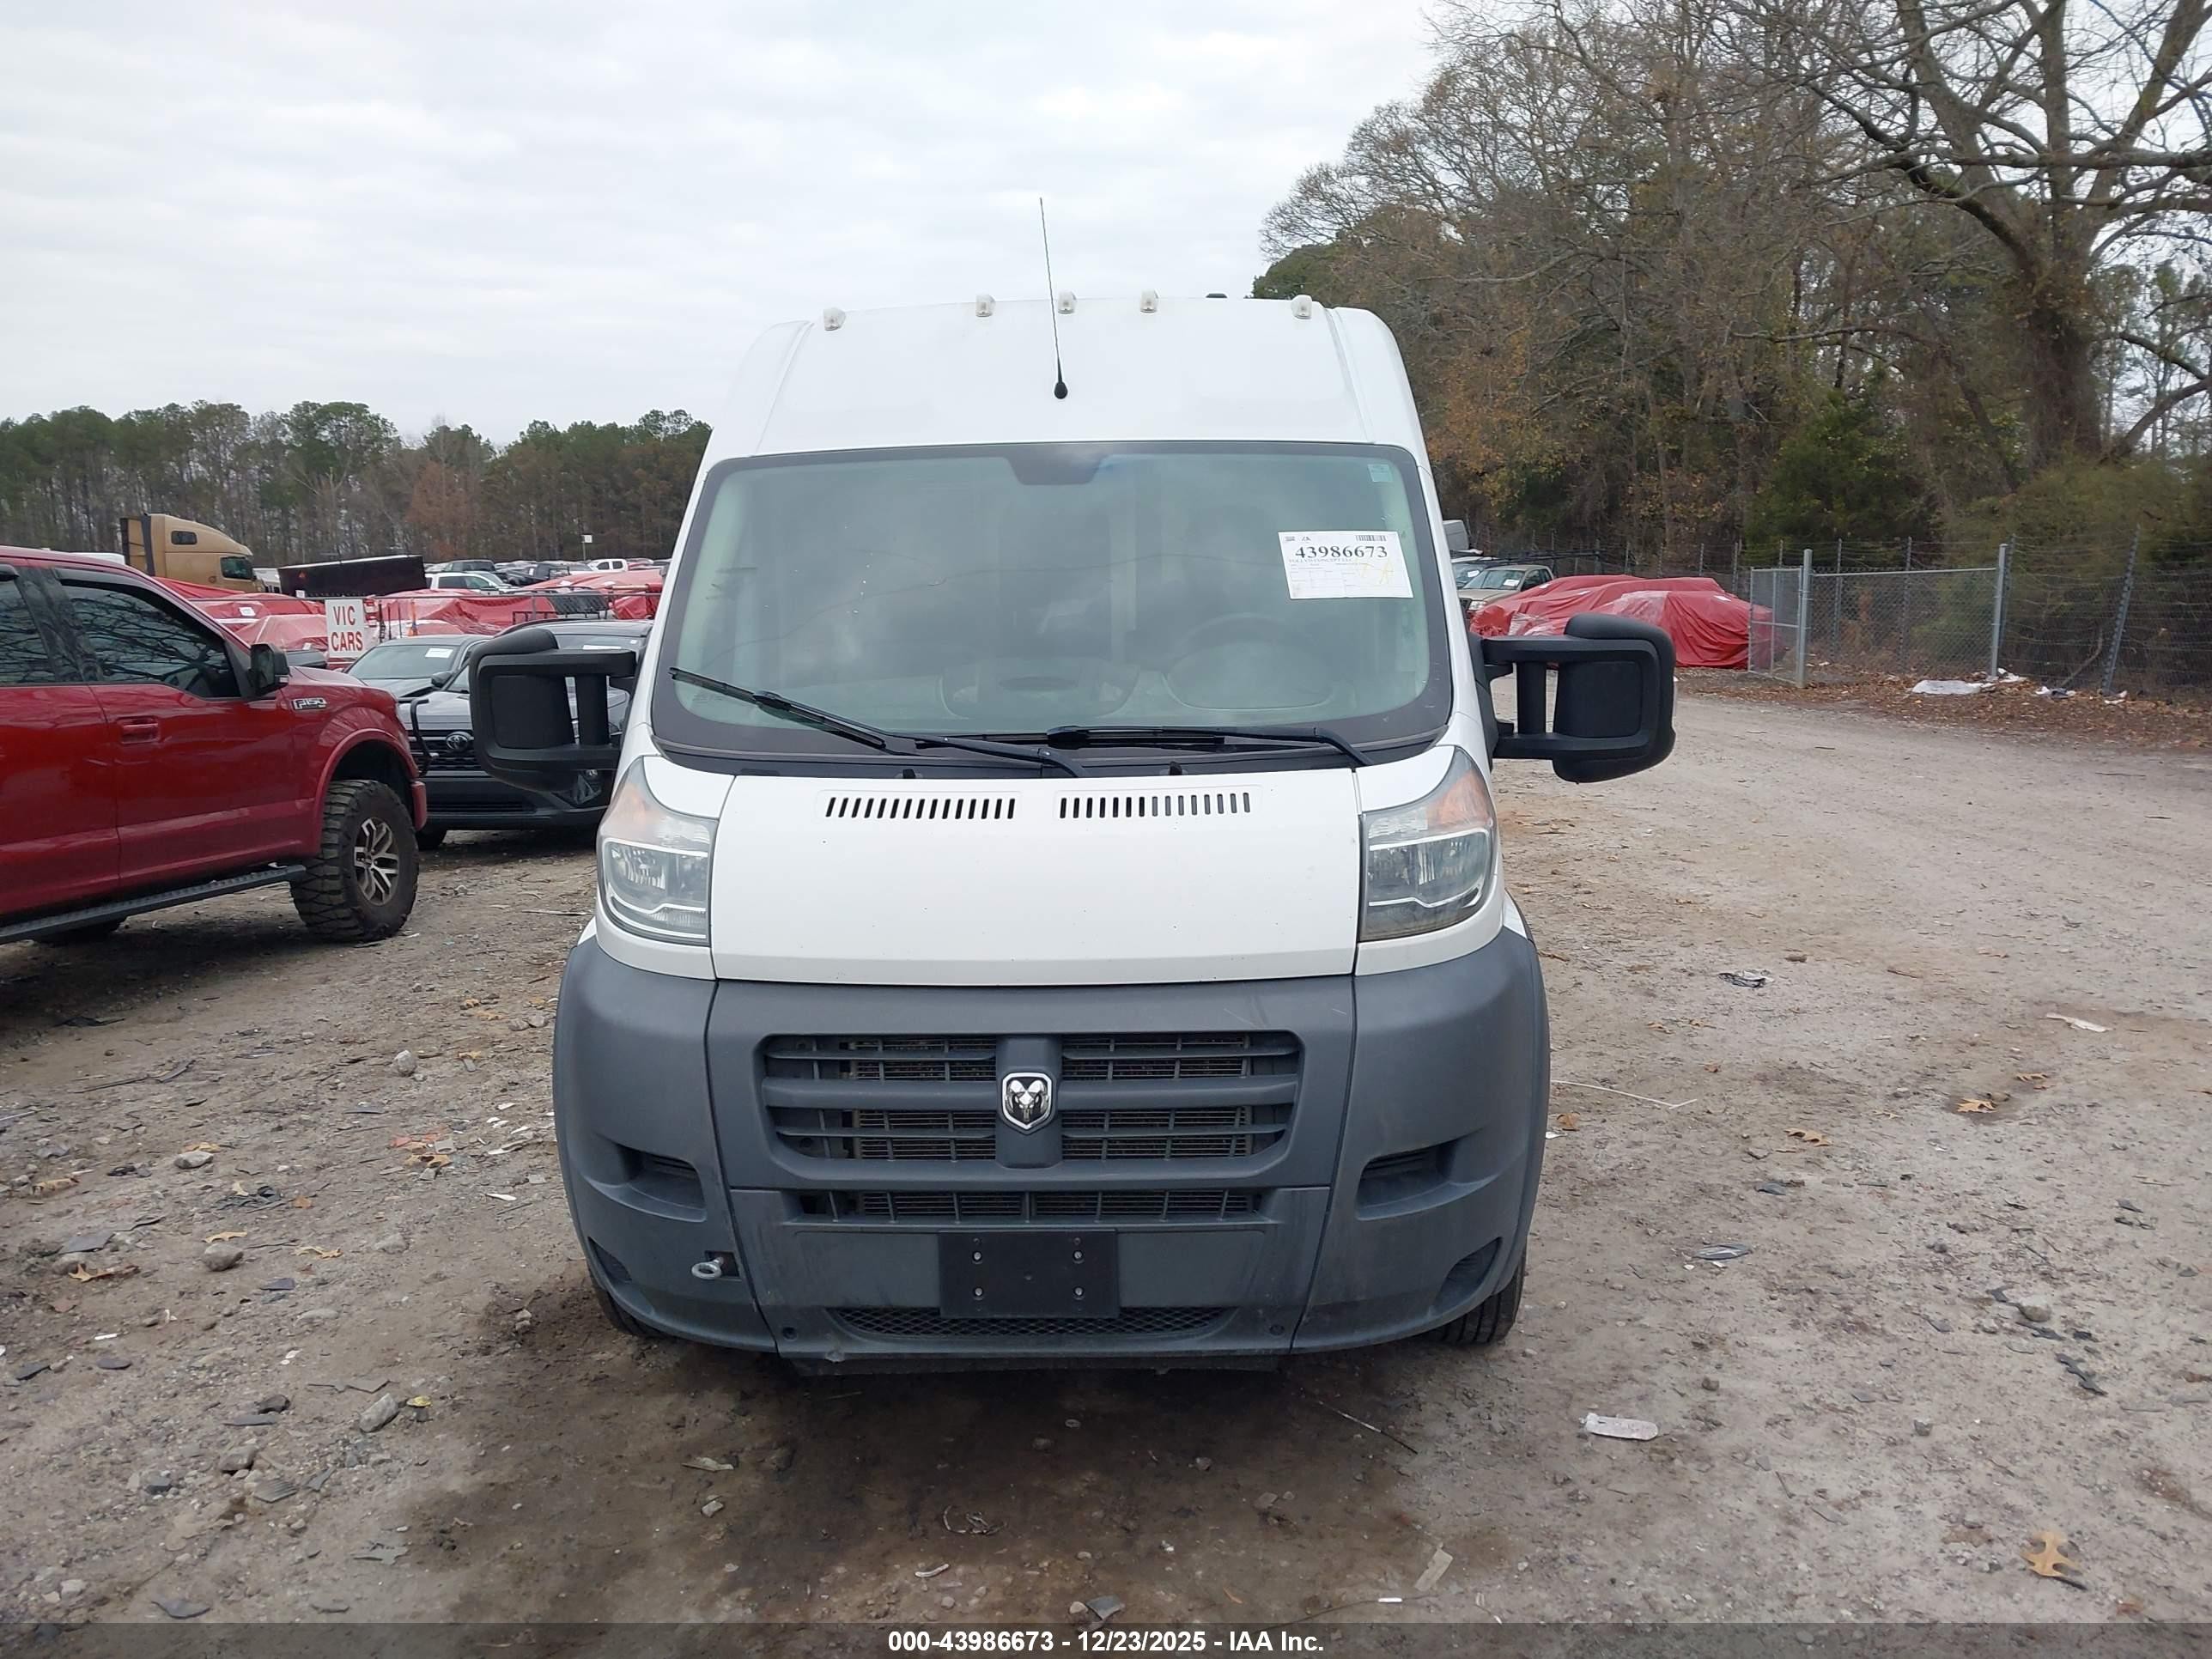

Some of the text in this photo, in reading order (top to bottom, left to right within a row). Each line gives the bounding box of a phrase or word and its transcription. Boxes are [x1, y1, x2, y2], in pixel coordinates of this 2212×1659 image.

[1295, 545, 1388, 558] 43986673
[333, 605, 356, 626] VIC
[331, 631, 363, 651] CARS
